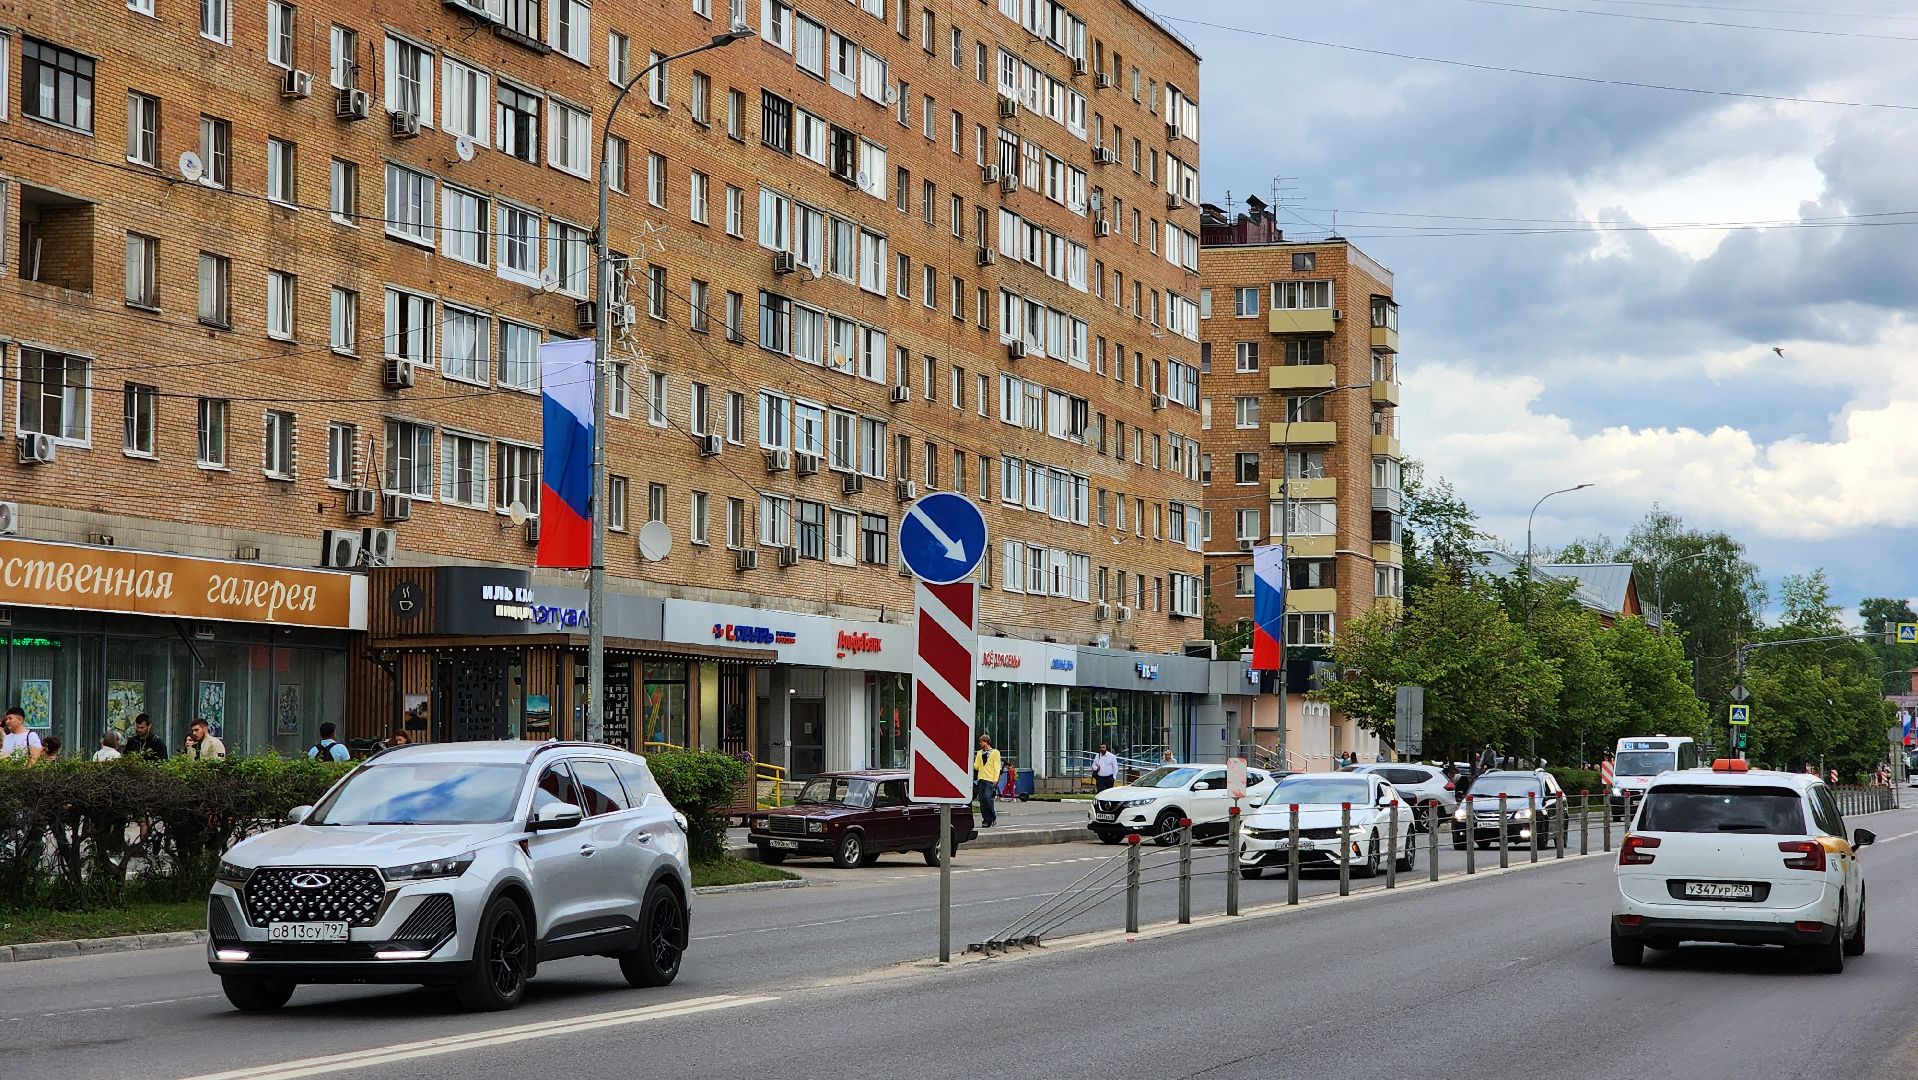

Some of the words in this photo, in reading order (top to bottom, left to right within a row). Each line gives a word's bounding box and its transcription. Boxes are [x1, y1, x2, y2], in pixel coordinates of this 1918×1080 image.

[0, 556, 173, 600] ственная
[206, 573, 317, 621] галерея
[482, 585, 513, 600] ИЛЬ
[1689, 883, 1731, 896] У347УР
[1733, 884, 1750, 894] 750
[272, 924, 322, 938] О813СУ
[324, 923, 345, 935] 797
